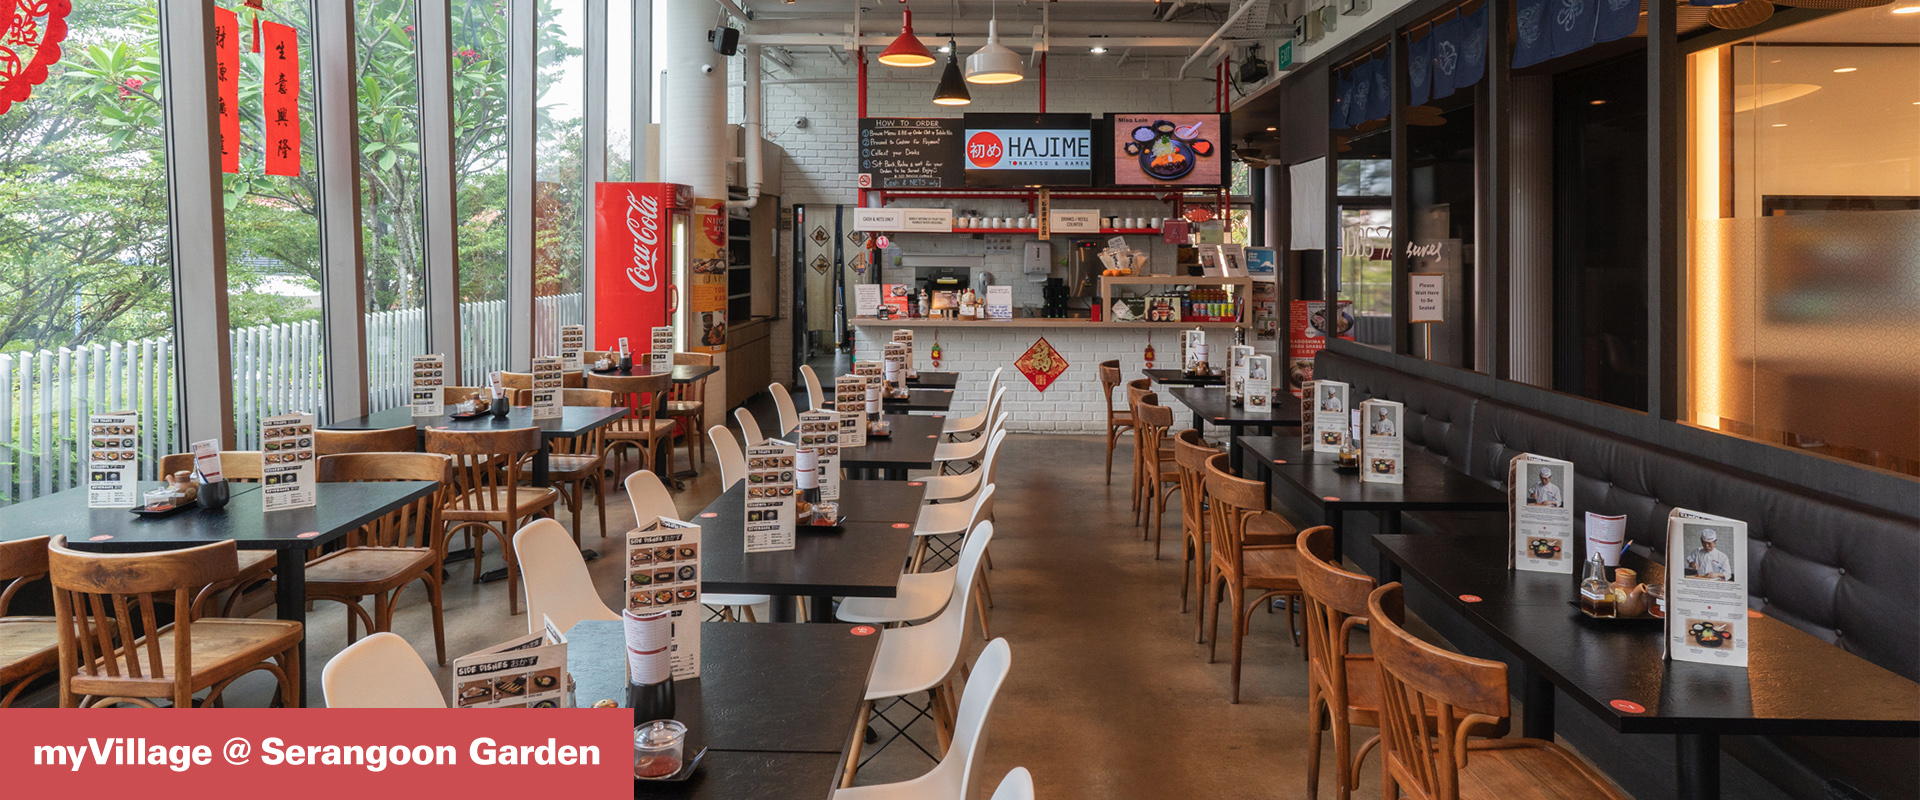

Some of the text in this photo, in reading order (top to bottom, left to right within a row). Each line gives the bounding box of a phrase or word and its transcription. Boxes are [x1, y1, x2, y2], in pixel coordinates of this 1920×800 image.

[274, 41, 292, 160] 生意興隆
[970, 142, 1002, 159] 初め
[1009, 137, 1089, 157] HAJIME
[872, 160, 882, 168] Sit
[626, 189, 658, 292] Coca-Cola
[459, 657, 536, 675] SIDE DISHES おかず
